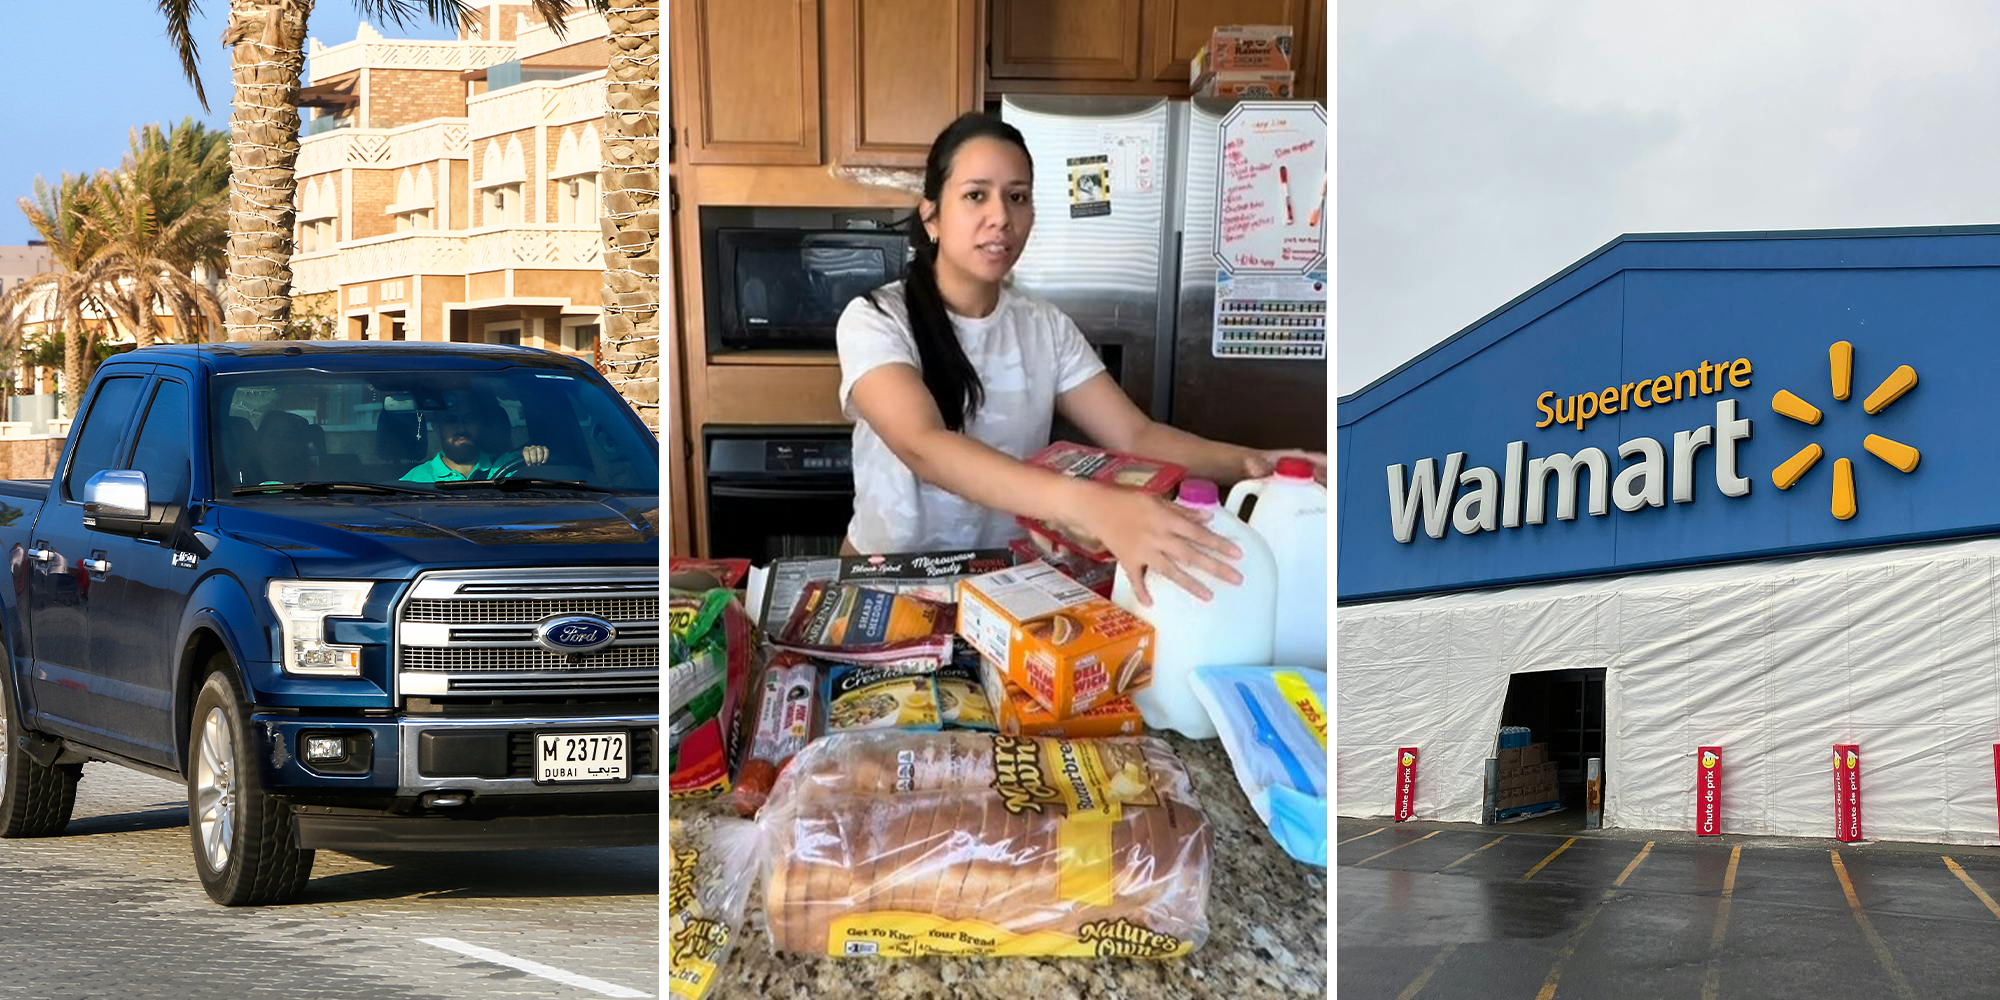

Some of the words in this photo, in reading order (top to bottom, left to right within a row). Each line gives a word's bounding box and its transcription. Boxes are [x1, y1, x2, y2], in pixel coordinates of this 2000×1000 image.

[1535, 356, 1753, 430] Supercentre
[1386, 399, 1753, 544] Walmart
[925, 564, 962, 577] Ready
[808, 590, 838, 642] ARGENTO
[858, 598, 874, 630] SHARP
[865, 592, 886, 638] CHEDDAR
[560, 625, 597, 643] Ford
[543, 740, 557, 761] M
[566, 737, 623, 761] 23772
[545, 767, 577, 778] DUBAI
[1403, 767, 1412, 783] prix
[1704, 770, 1716, 788] prix
[1848, 771, 1857, 790] prix
[1403, 783, 1410, 794] de
[1704, 790, 1714, 802] de
[1849, 792, 1857, 805] de
[1400, 794, 1408, 819] Chute
[1703, 803, 1713, 832] Chute
[1850, 806, 1858, 838] Chute
[846, 927, 868, 937] Get
[871, 927, 887, 938] To
[958, 930, 996, 947] Bread
[1078, 917, 1179, 952] Nature's
